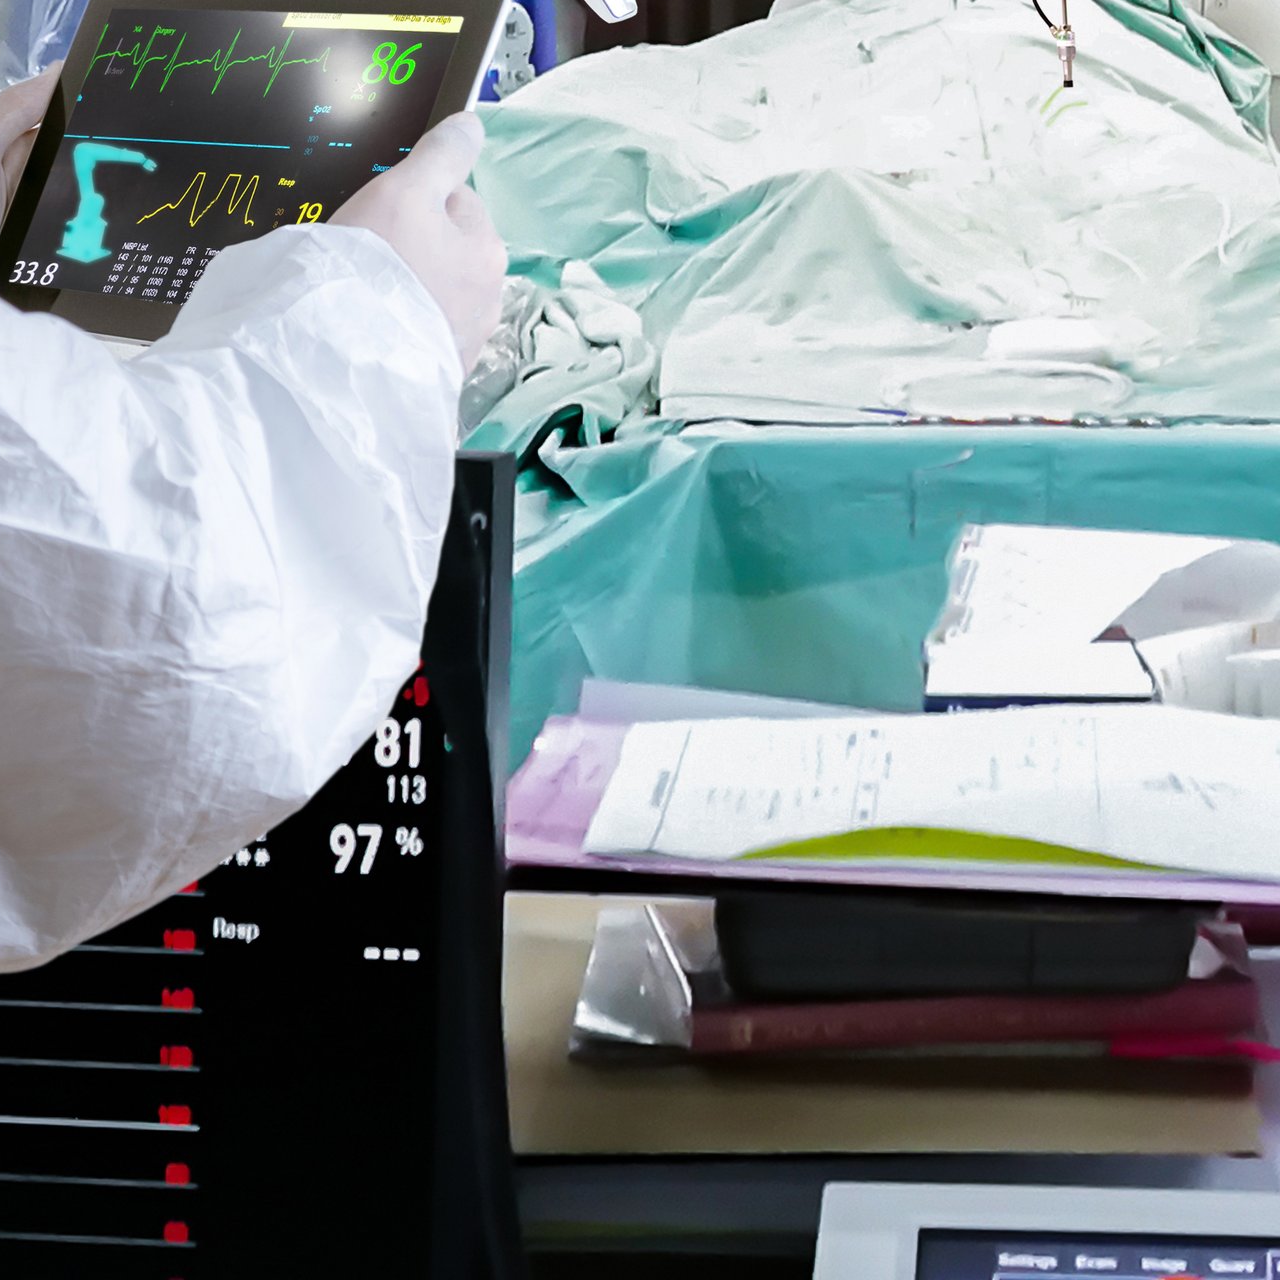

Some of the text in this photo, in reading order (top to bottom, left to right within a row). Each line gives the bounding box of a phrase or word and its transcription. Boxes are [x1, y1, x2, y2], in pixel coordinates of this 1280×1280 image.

[361, 41, 423, 85] 86
[277, 177, 296, 187] Resp
[295, 202, 323, 225] 19
[141, 254, 153, 263] 101
[185, 246, 197, 255] PR
[8, 260, 59, 286] 33.8
[374, 717, 422, 768] 81
[386, 775, 427, 805] 113
[329, 823, 383, 875] 97
